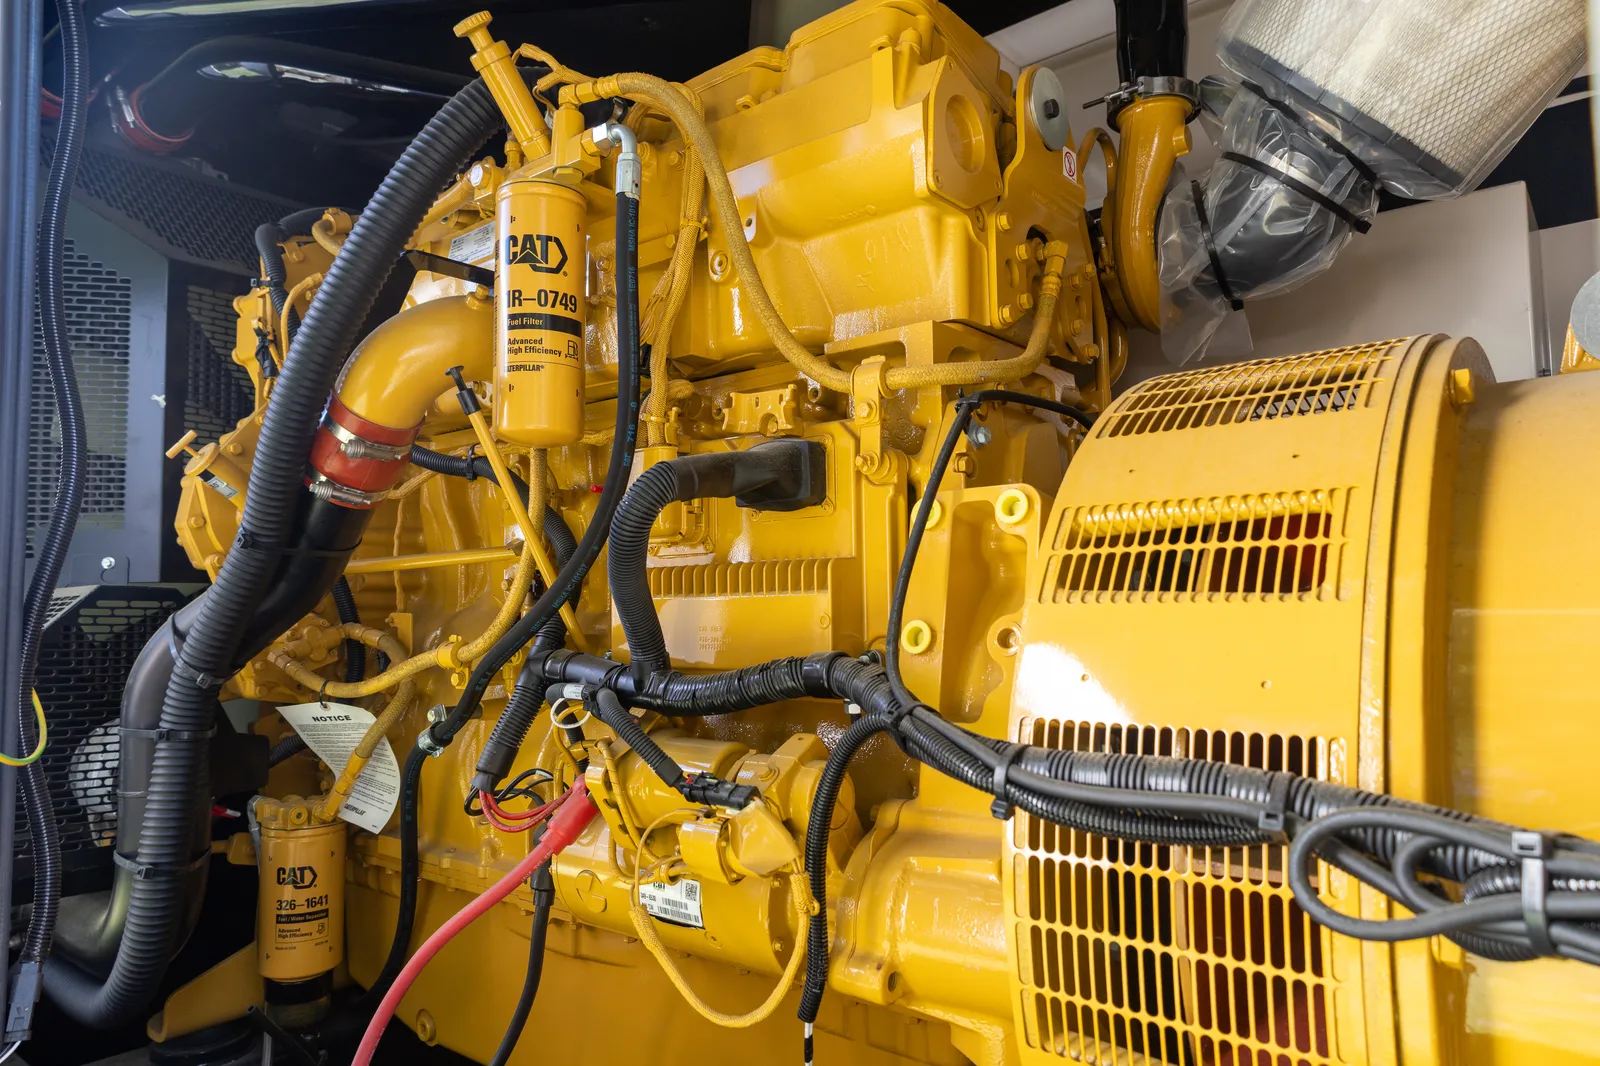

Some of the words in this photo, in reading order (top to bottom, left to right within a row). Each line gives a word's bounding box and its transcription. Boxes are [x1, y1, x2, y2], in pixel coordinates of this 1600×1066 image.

[628, 229, 636, 252] MSHA
[505, 234, 560, 268] CAT
[508, 317, 521, 326] Fuel
[523, 317, 543, 326] Filter
[508, 346, 522, 355] High
[525, 345, 562, 358] Efficiency
[627, 423, 636, 442] 716
[311, 714, 352, 723] NOTICE
[276, 866, 312, 887] CAT
[276, 894, 329, 911] 326-1641
